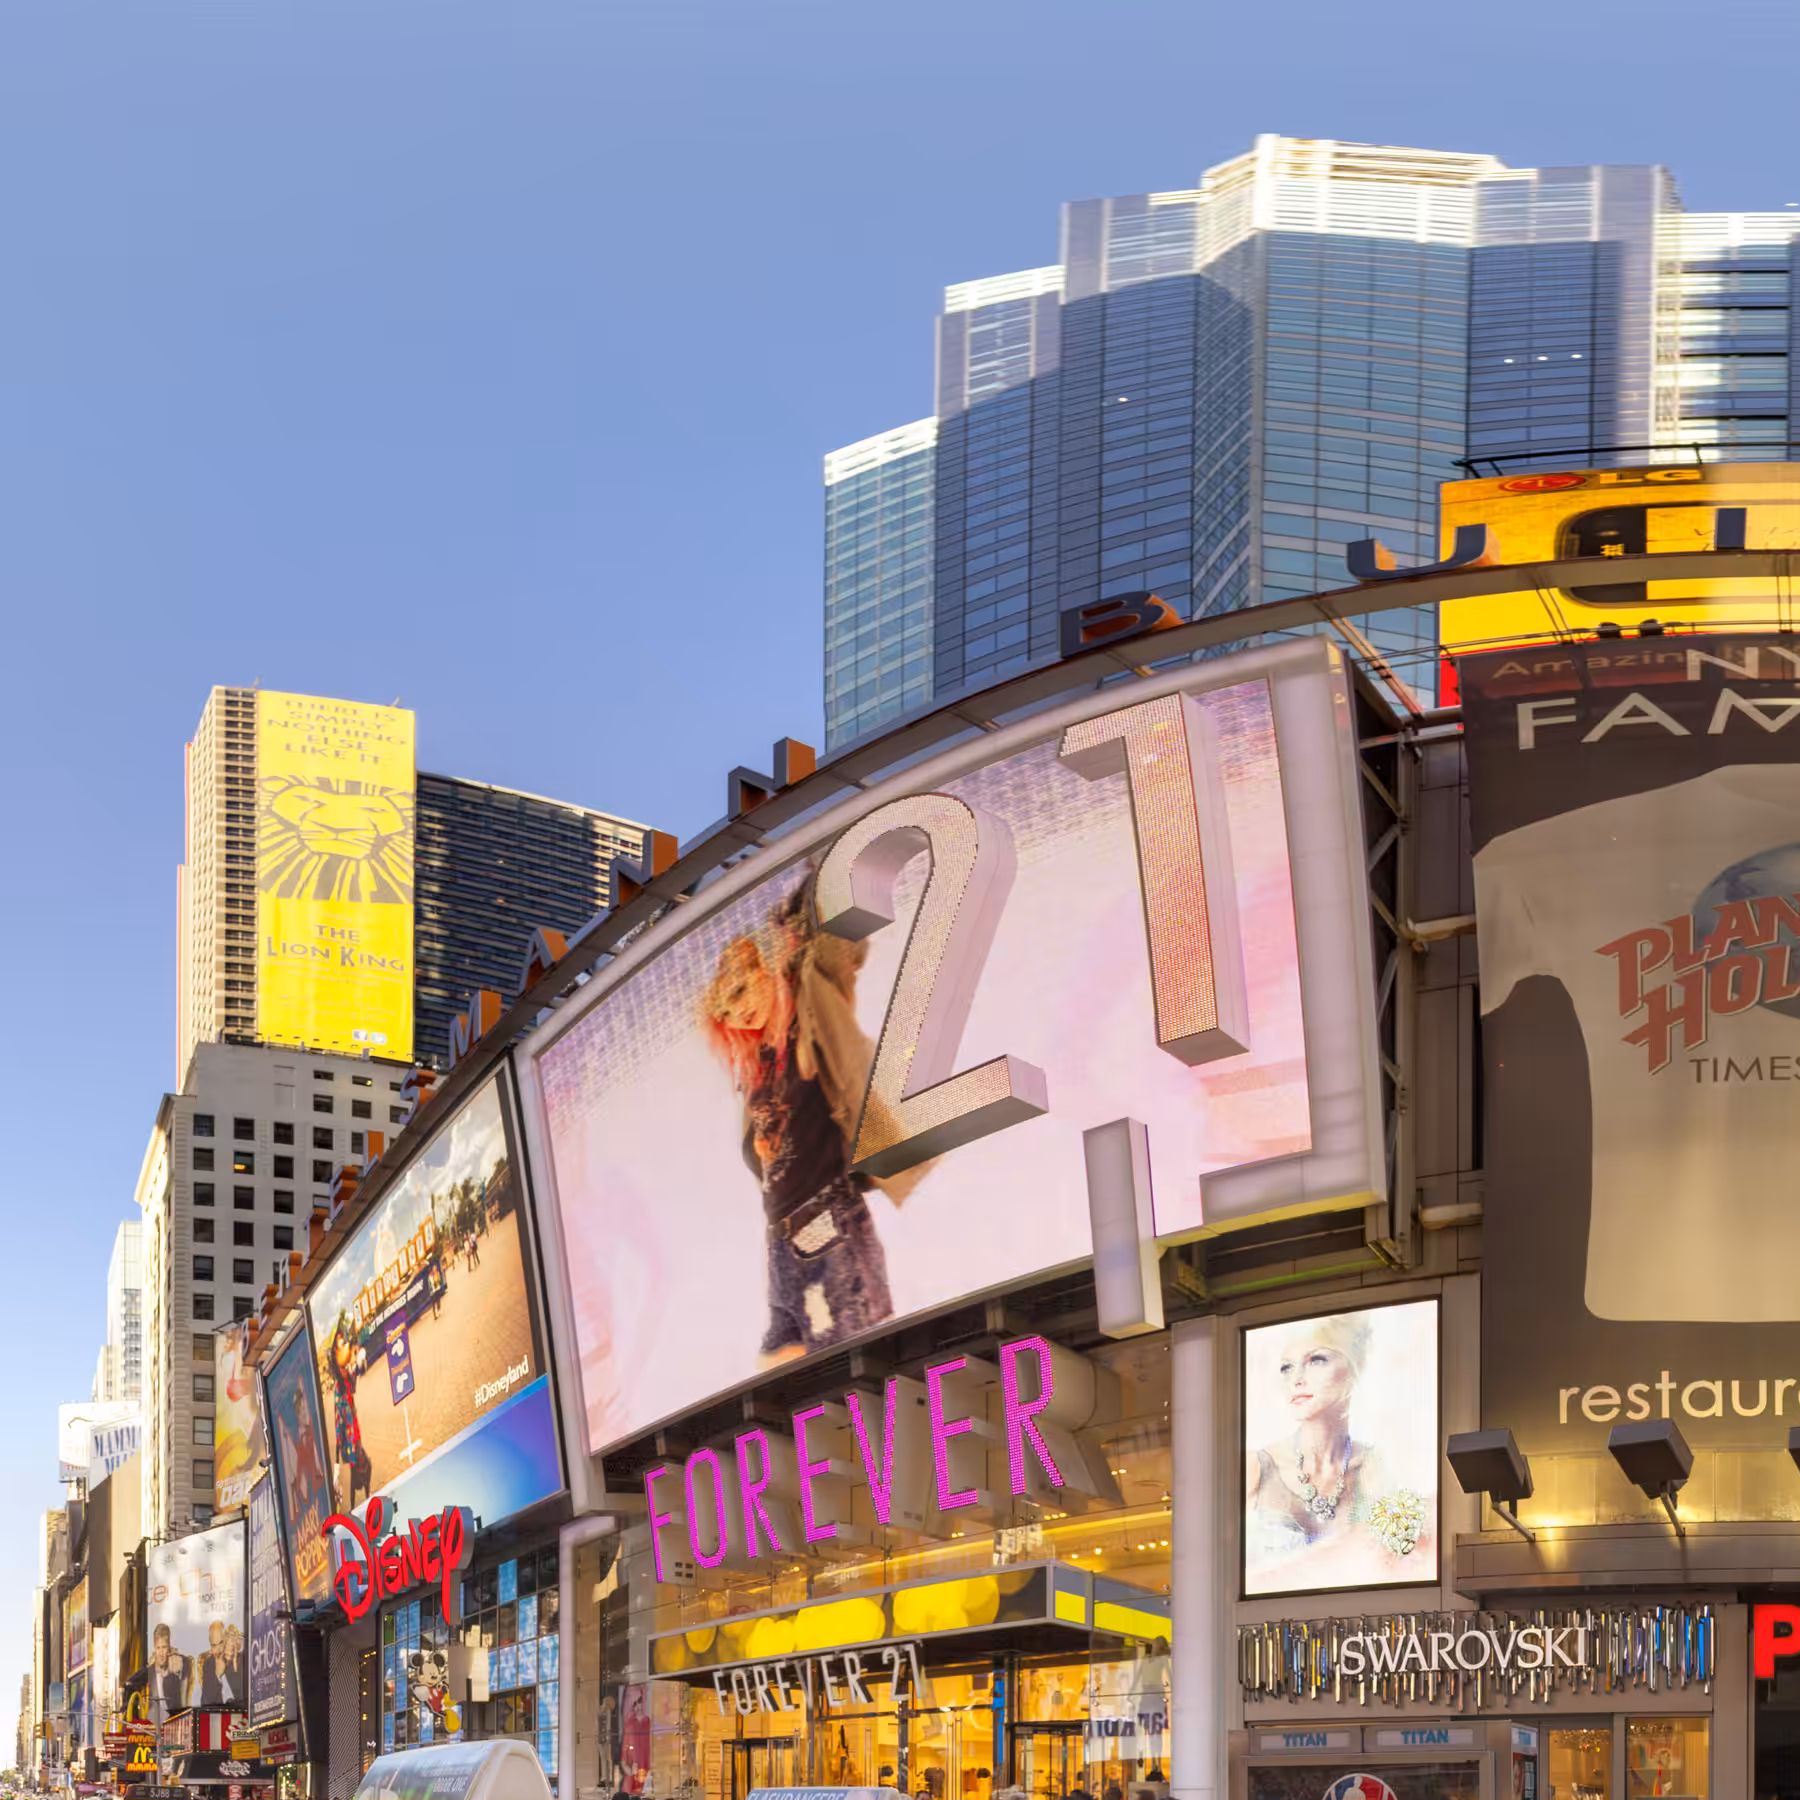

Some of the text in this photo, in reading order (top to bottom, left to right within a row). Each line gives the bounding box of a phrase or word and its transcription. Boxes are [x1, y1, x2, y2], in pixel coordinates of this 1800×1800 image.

[266, 937, 405, 972] LION KING
[316, 925, 361, 942] THE
[473, 1354, 530, 1408] #Disneyland
[643, 1334, 1066, 1584] FOREVER
[1340, 1627, 1589, 1676] SWAROVSKI
[712, 1655, 872, 1719] FOREVER
[1281, 1733, 1328, 1748] TITAN
